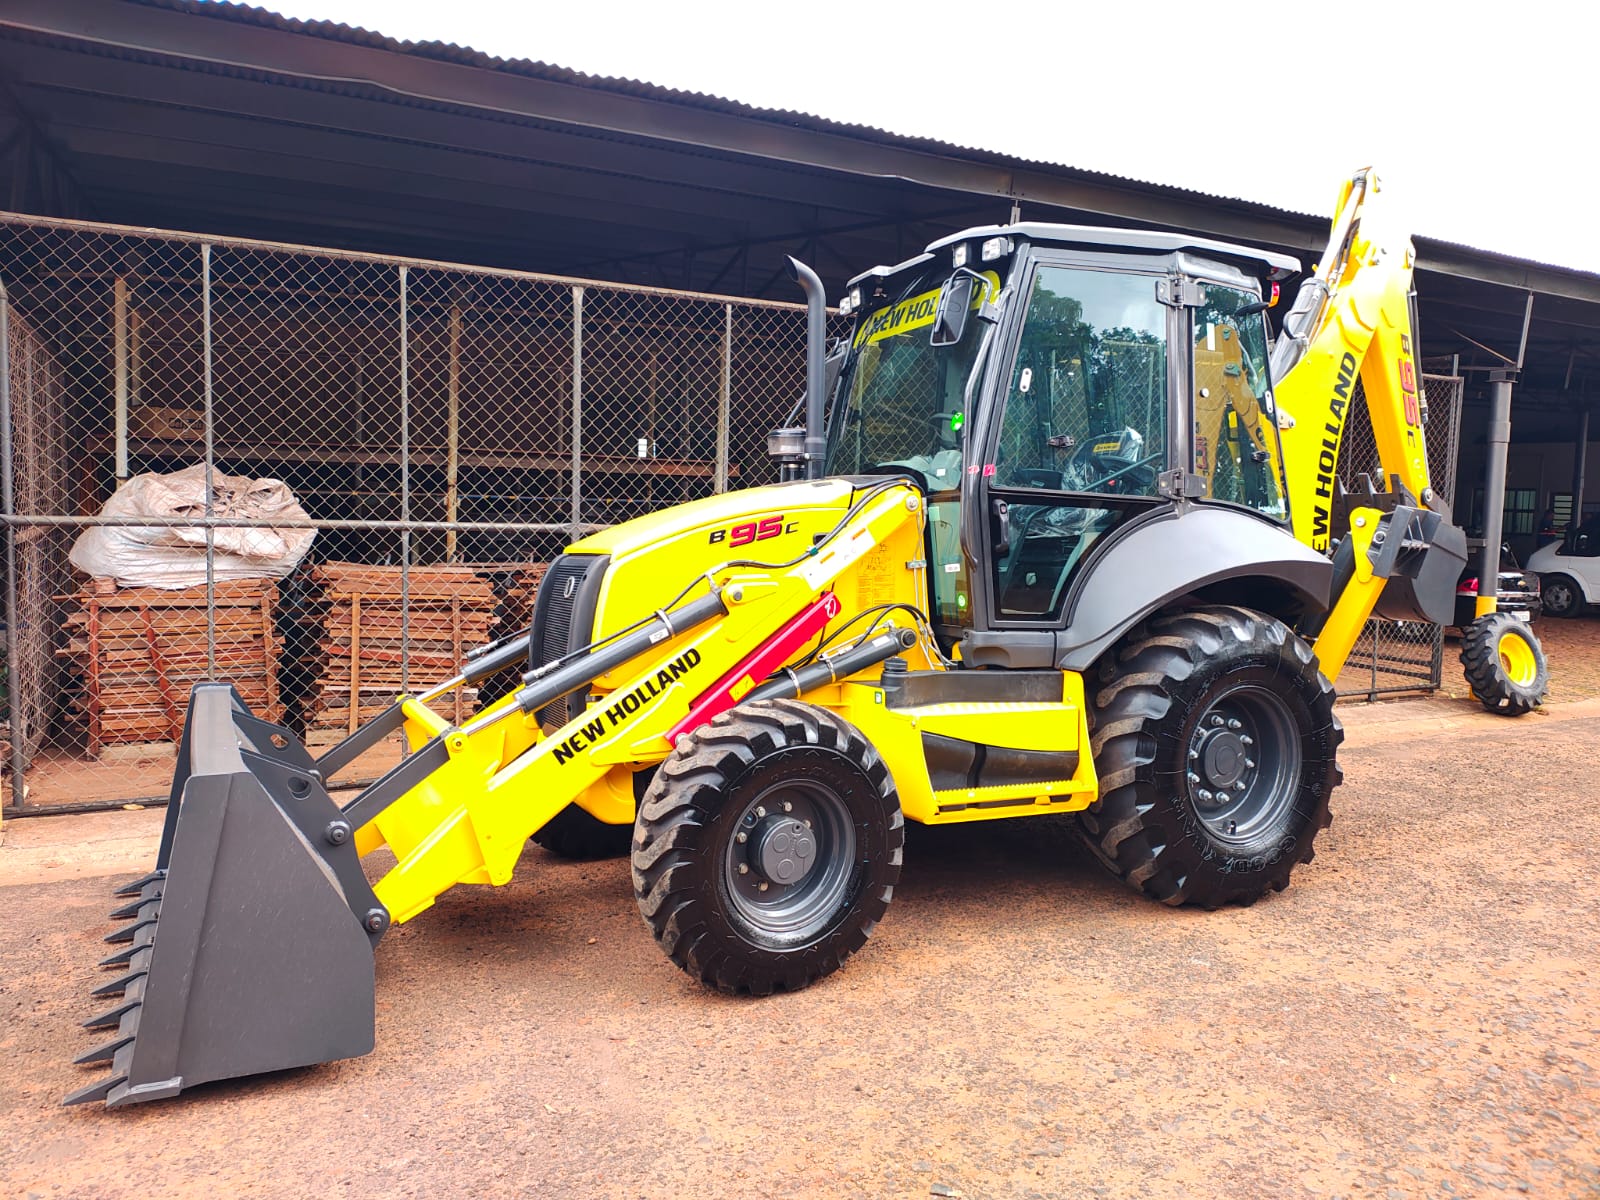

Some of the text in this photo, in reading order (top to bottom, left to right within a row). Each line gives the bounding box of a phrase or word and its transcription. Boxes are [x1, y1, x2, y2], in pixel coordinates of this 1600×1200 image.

[871, 307, 905, 333] NEW
[1312, 352, 1356, 555] EW HOLLAND
[552, 648, 701, 765] NEW HOLLAND
